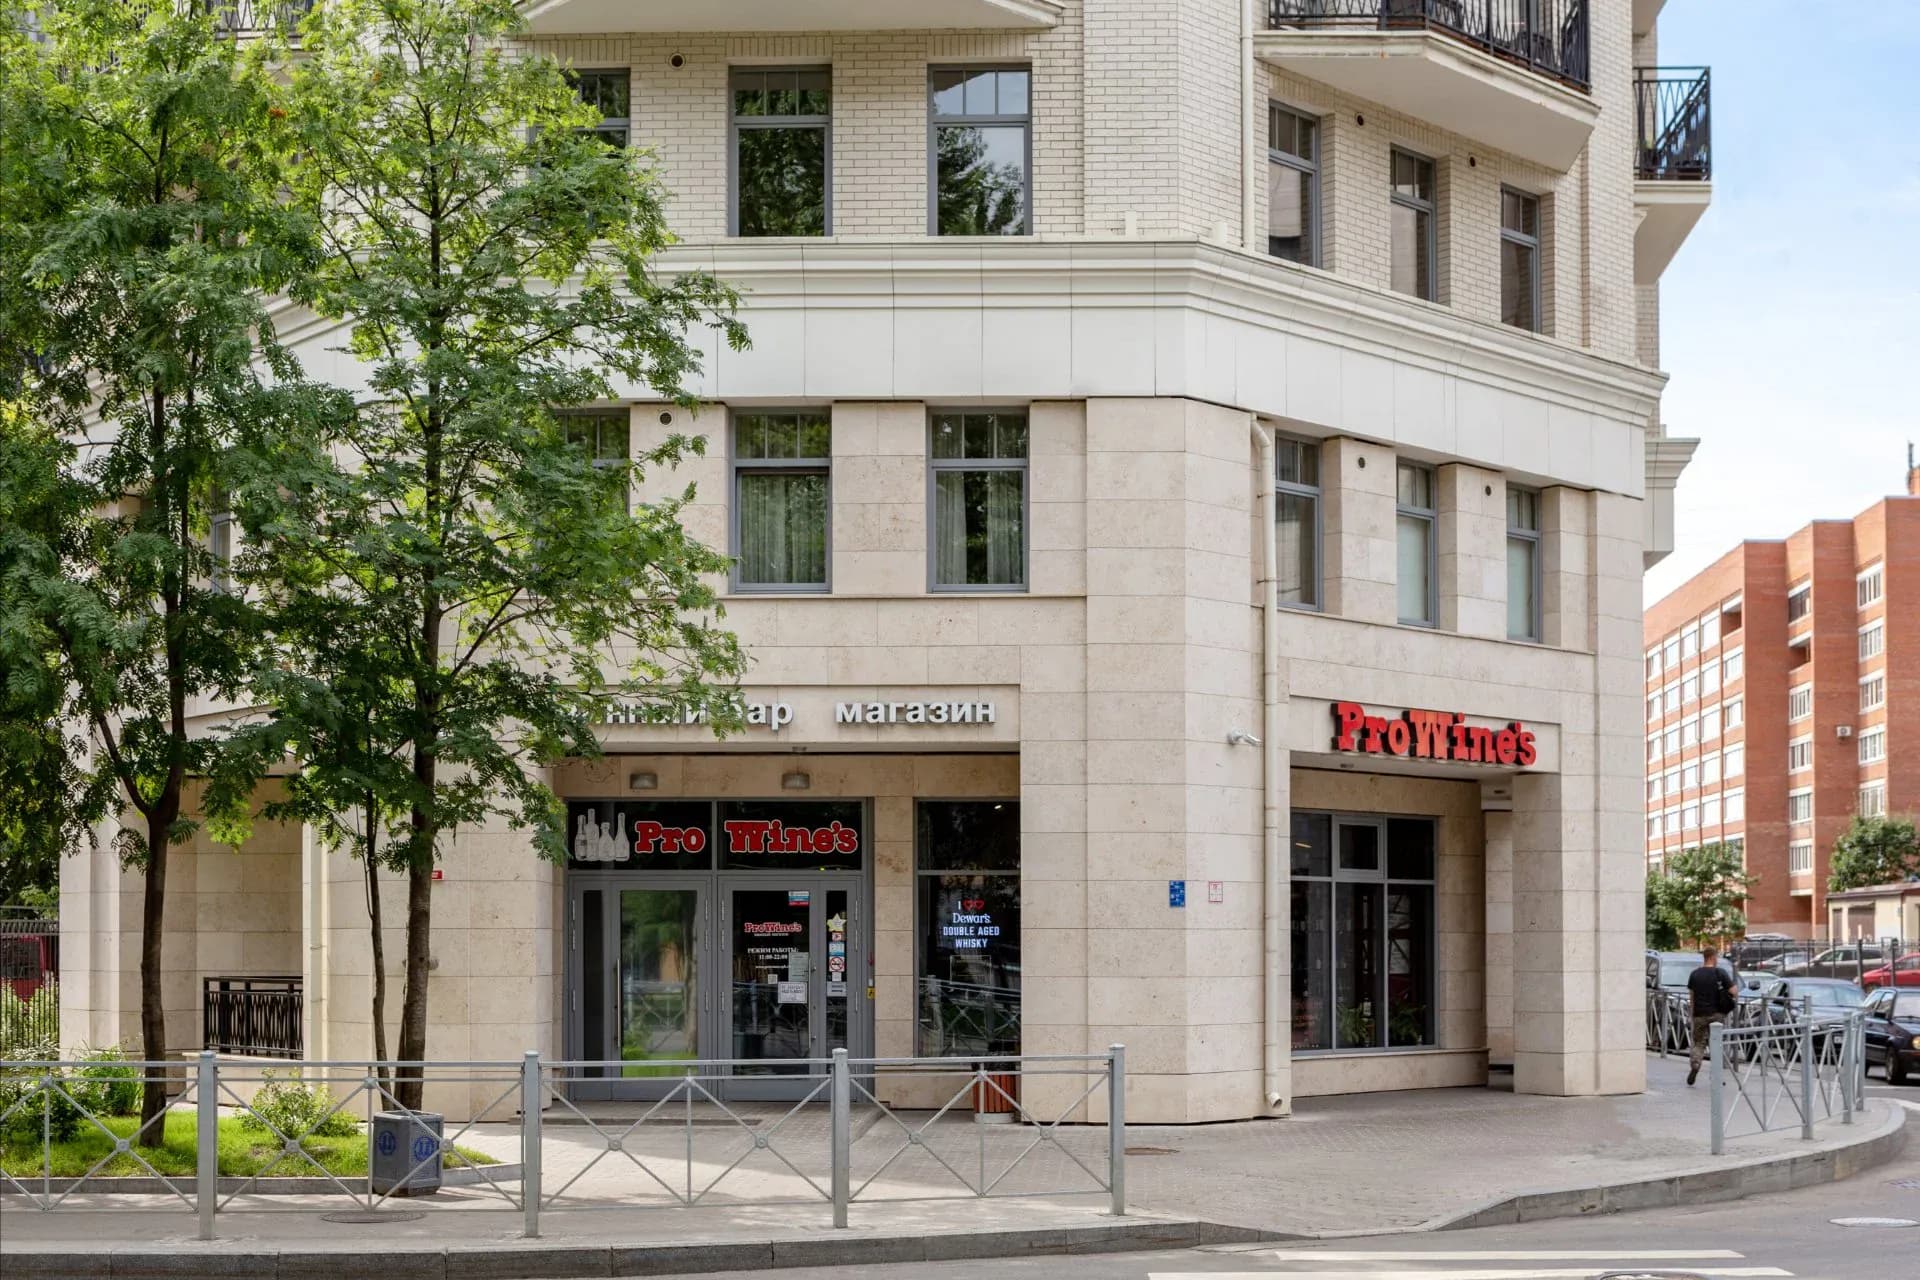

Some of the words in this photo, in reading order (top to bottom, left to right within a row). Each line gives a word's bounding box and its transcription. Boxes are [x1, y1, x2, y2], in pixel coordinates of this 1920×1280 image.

[835, 702, 996, 723] магазин
[1331, 702, 1537, 766] ProWine's
[635, 820, 706, 853] Pro
[724, 819, 858, 853] Wine's
[943, 926, 975, 936] DOUBLE
[977, 926, 1000, 936] AGED
[955, 938, 988, 948] WHISKY
